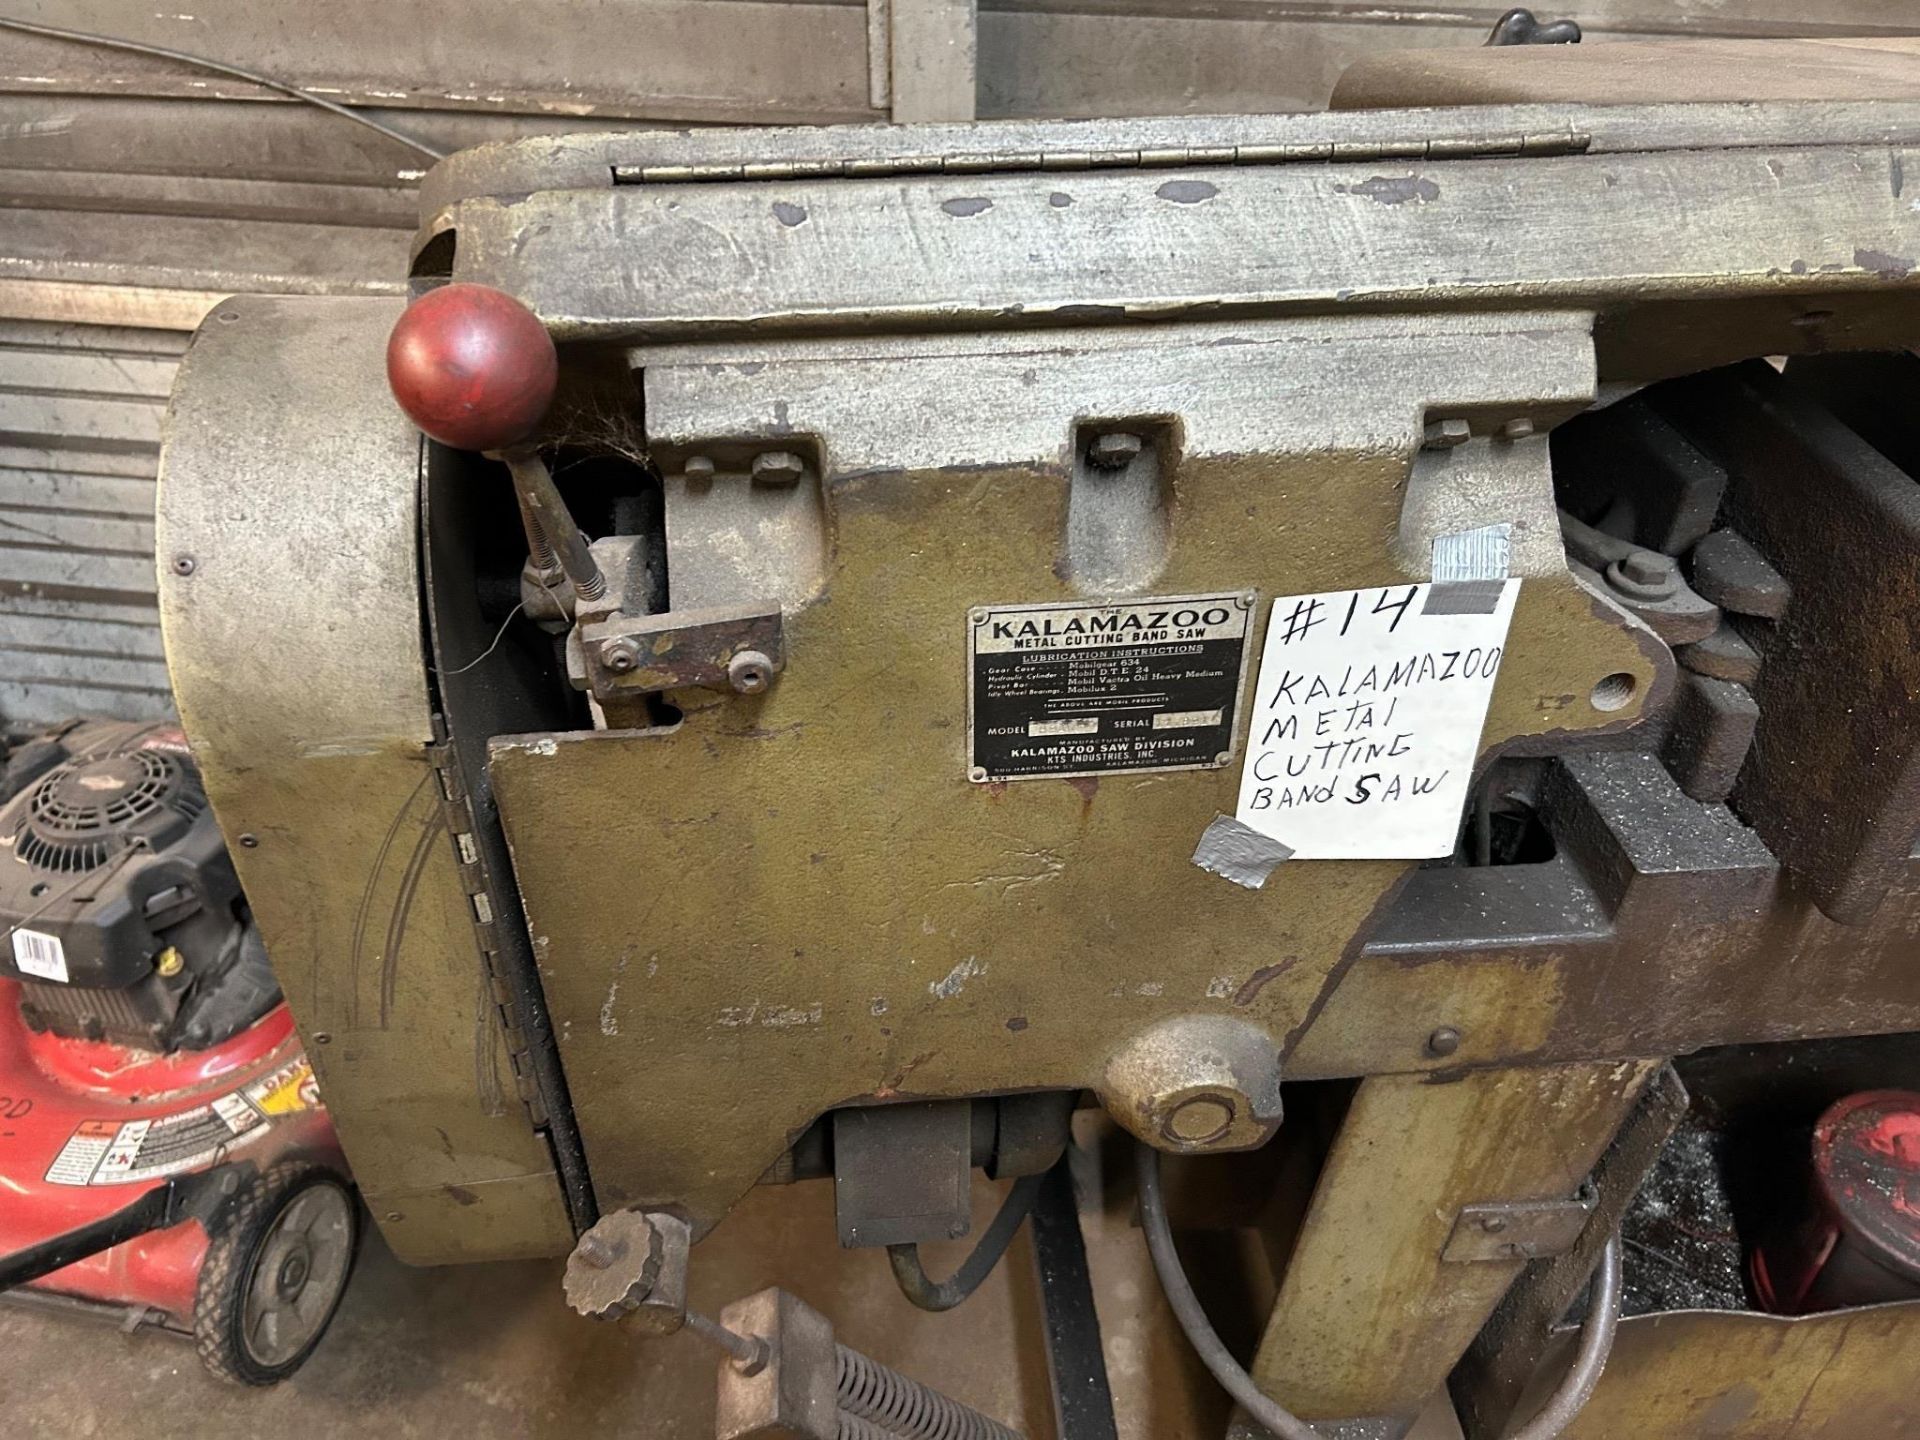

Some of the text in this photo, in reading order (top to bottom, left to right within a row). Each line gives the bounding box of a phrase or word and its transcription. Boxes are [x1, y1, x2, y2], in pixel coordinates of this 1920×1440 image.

[993, 608, 1230, 639] KALAMAZOO
[1281, 586, 1419, 645] #14
[1014, 628, 1206, 649] METAL CUTTING BAND SAW
[1022, 644, 1204, 662] LUBRICATION INSTRUCTIONS
[1069, 661, 1117, 671] Mobilgear
[1120, 658, 1140, 667] 634
[988, 674, 1022, 682] Hydraulic
[1026, 672, 1058, 681] Cylinder
[1068, 669, 1096, 678] Mobil
[1067, 677, 1095, 686] Mobil
[1099, 676, 1130, 684] Vactra
[1151, 672, 1182, 681] Heavy
[1185, 670, 1224, 678] Medium
[1270, 647, 1504, 708] KALAMAZOO
[1067, 685, 1106, 694] Mobilux
[987, 726, 1026, 735] MODEL
[1113, 719, 1150, 728] SERIAL
[1011, 738, 1195, 758] KALAMAZOO SAW DIVISION
[1059, 737, 1130, 745] MANUFACTURED
[1047, 755, 1066, 764] KTS
[1163, 755, 1207, 763] MICHIGAN
[1254, 733, 1415, 781] CUTTING
[1345, 769, 1450, 804] SAW
